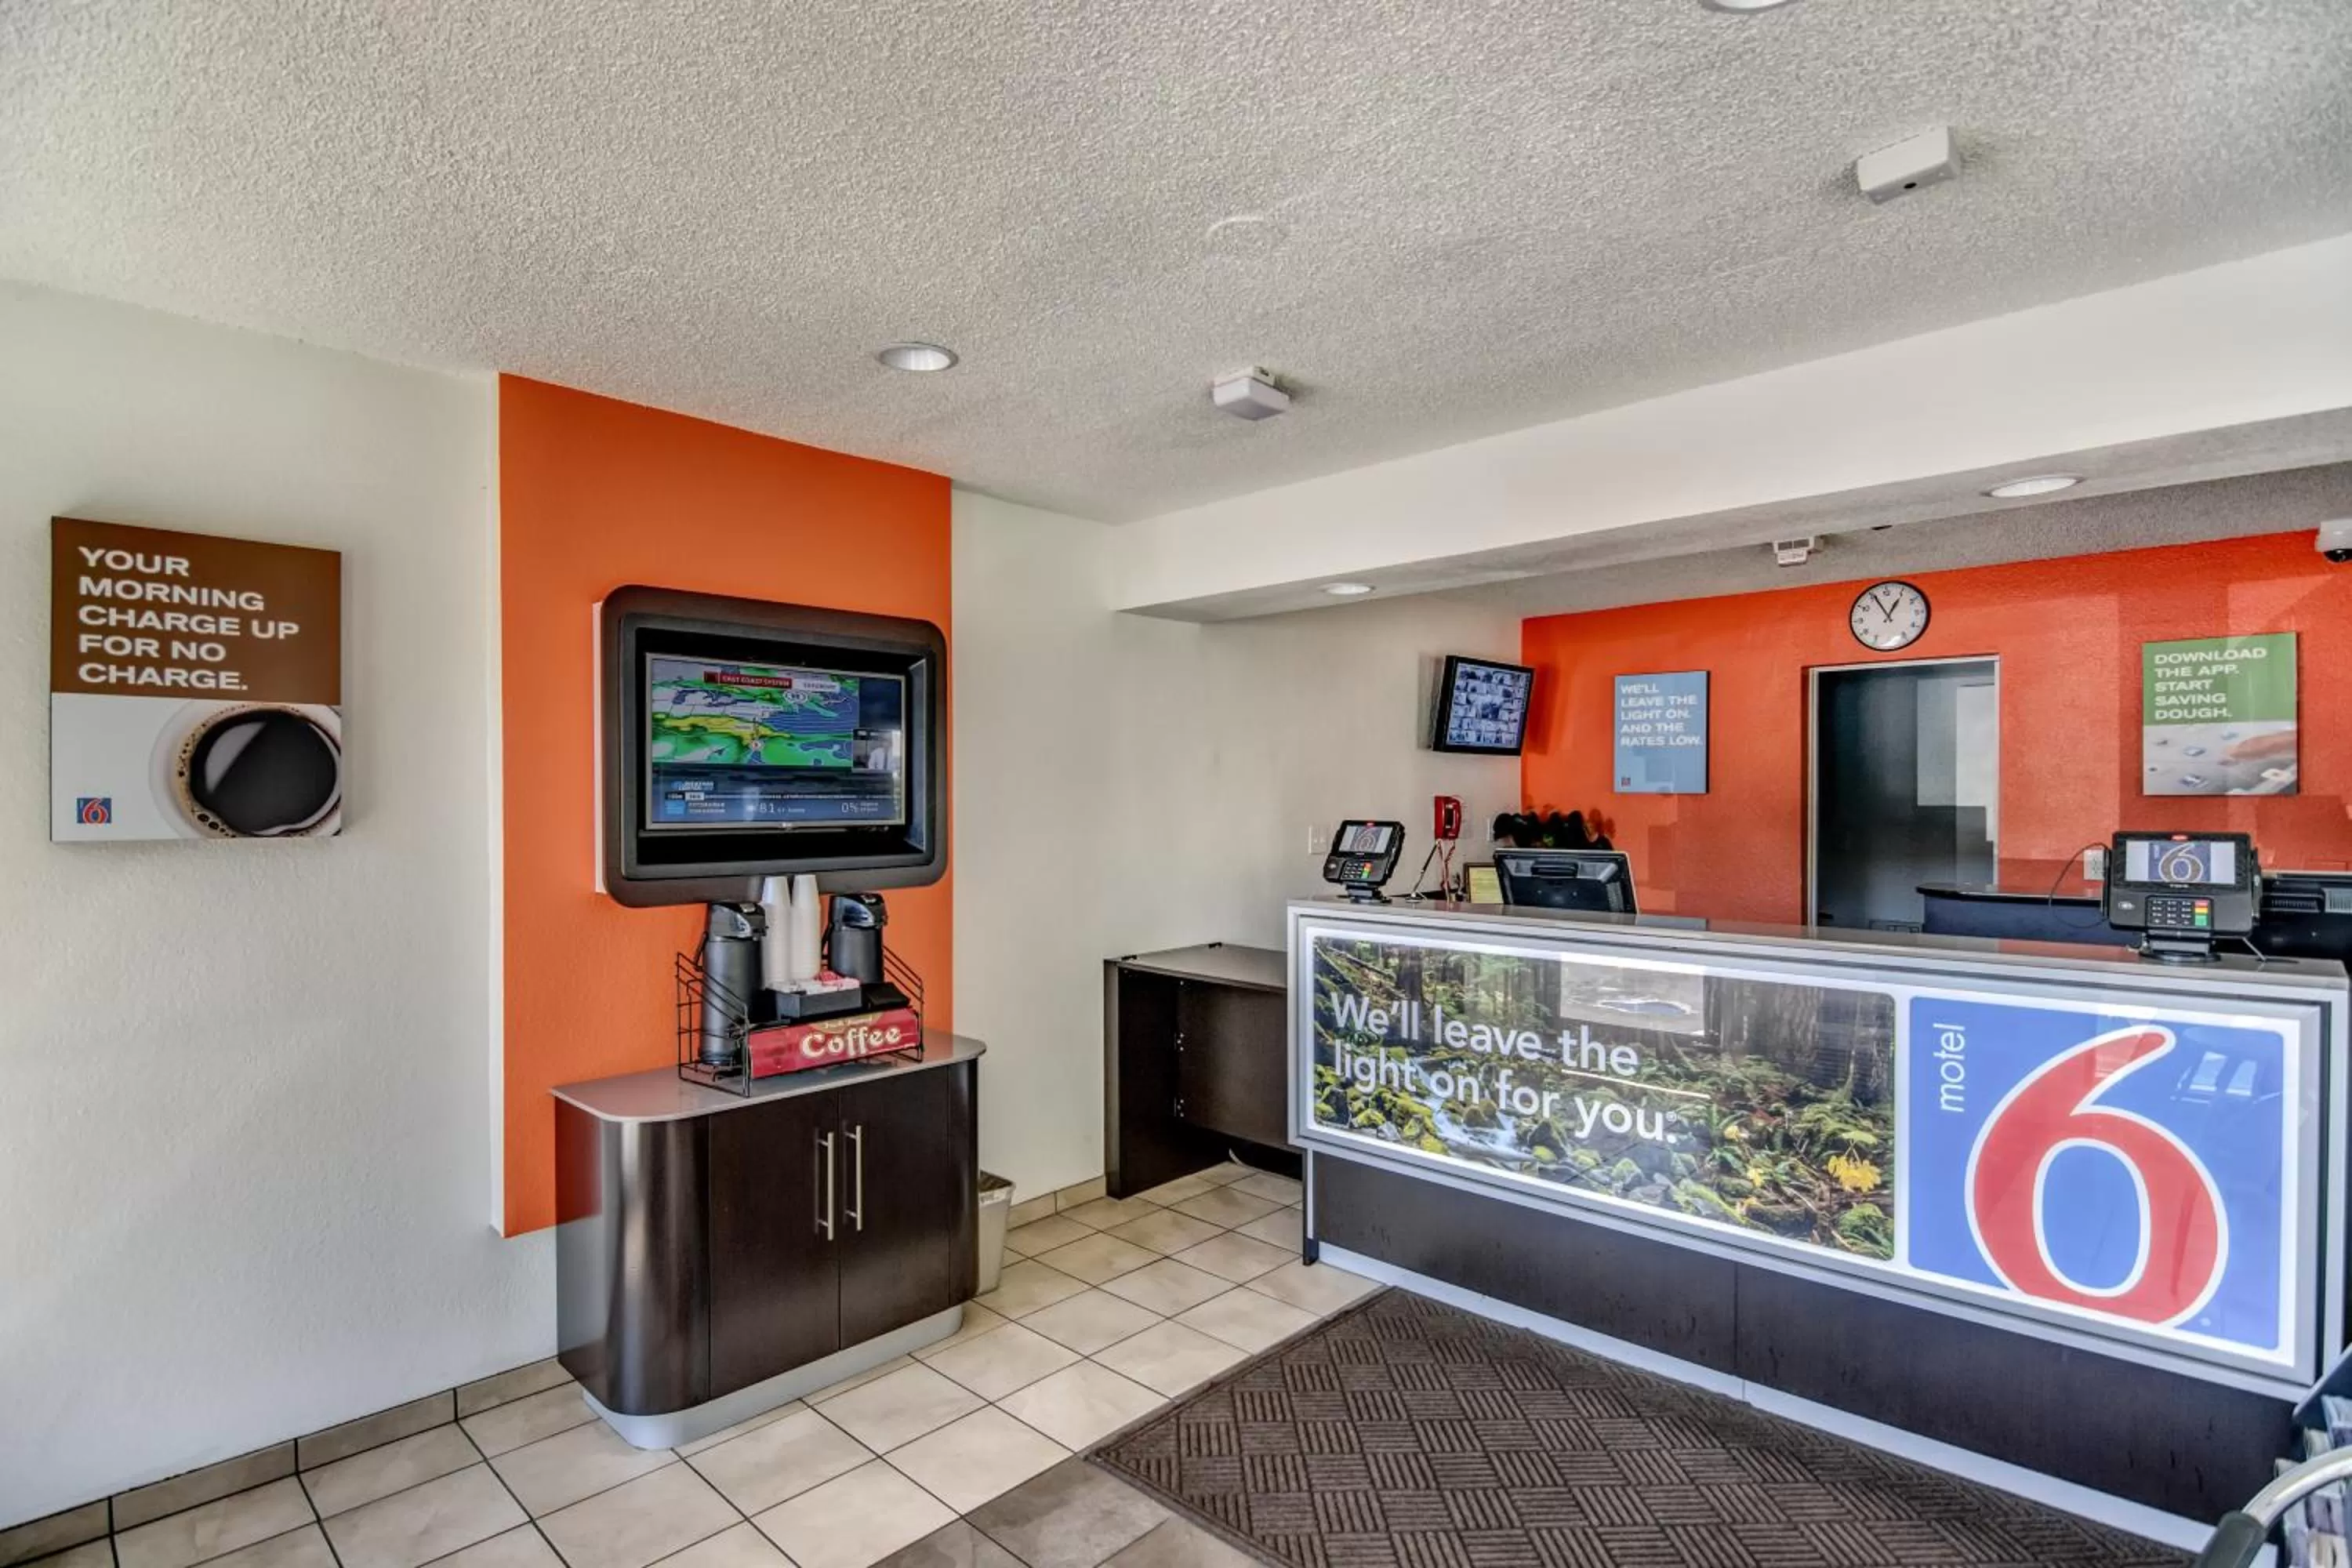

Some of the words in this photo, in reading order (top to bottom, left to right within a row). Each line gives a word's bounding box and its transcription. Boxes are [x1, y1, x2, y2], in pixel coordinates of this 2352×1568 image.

[78, 546, 190, 576] YOUR
[79, 576, 265, 611] MORNING
[78, 604, 241, 636] CHARGE
[251, 620, 299, 640] UP
[79, 633, 160, 659] FOR
[171, 641, 227, 662] NO
[2154, 647, 2268, 665] DOWNLOAD
[78, 662, 249, 691] CHARGE.
[2154, 666, 2193, 678] THE
[2198, 664, 2240, 677] APP.
[1620, 683, 1660, 695] WE'LL
[2154, 679, 2214, 692] START
[2154, 692, 2227, 706] SAVING
[1621, 696, 1664, 707] LEAVE
[1668, 695, 1697, 706] THE
[1621, 709, 1663, 720] LIGHT
[2154, 707, 2234, 720] DOUGH.
[1621, 723, 1653, 733] AND
[1656, 722, 1685, 732] THE
[1621, 735, 1664, 746] RATES
[82, 797, 109, 825] 6
[2158, 841, 2204, 884] 6
[802, 1025, 902, 1058] Coffee
[1331, 992, 1420, 1040] We'll
[1435, 1006, 1542, 1060] leave
[1558, 1023, 1639, 1076] the
[1333, 1038, 1417, 1094] light
[1430, 1069, 1480, 1105] on
[1495, 1069, 1561, 1118] for
[1933, 1023, 1965, 1113] motel
[1965, 1024, 2229, 1330] 6
